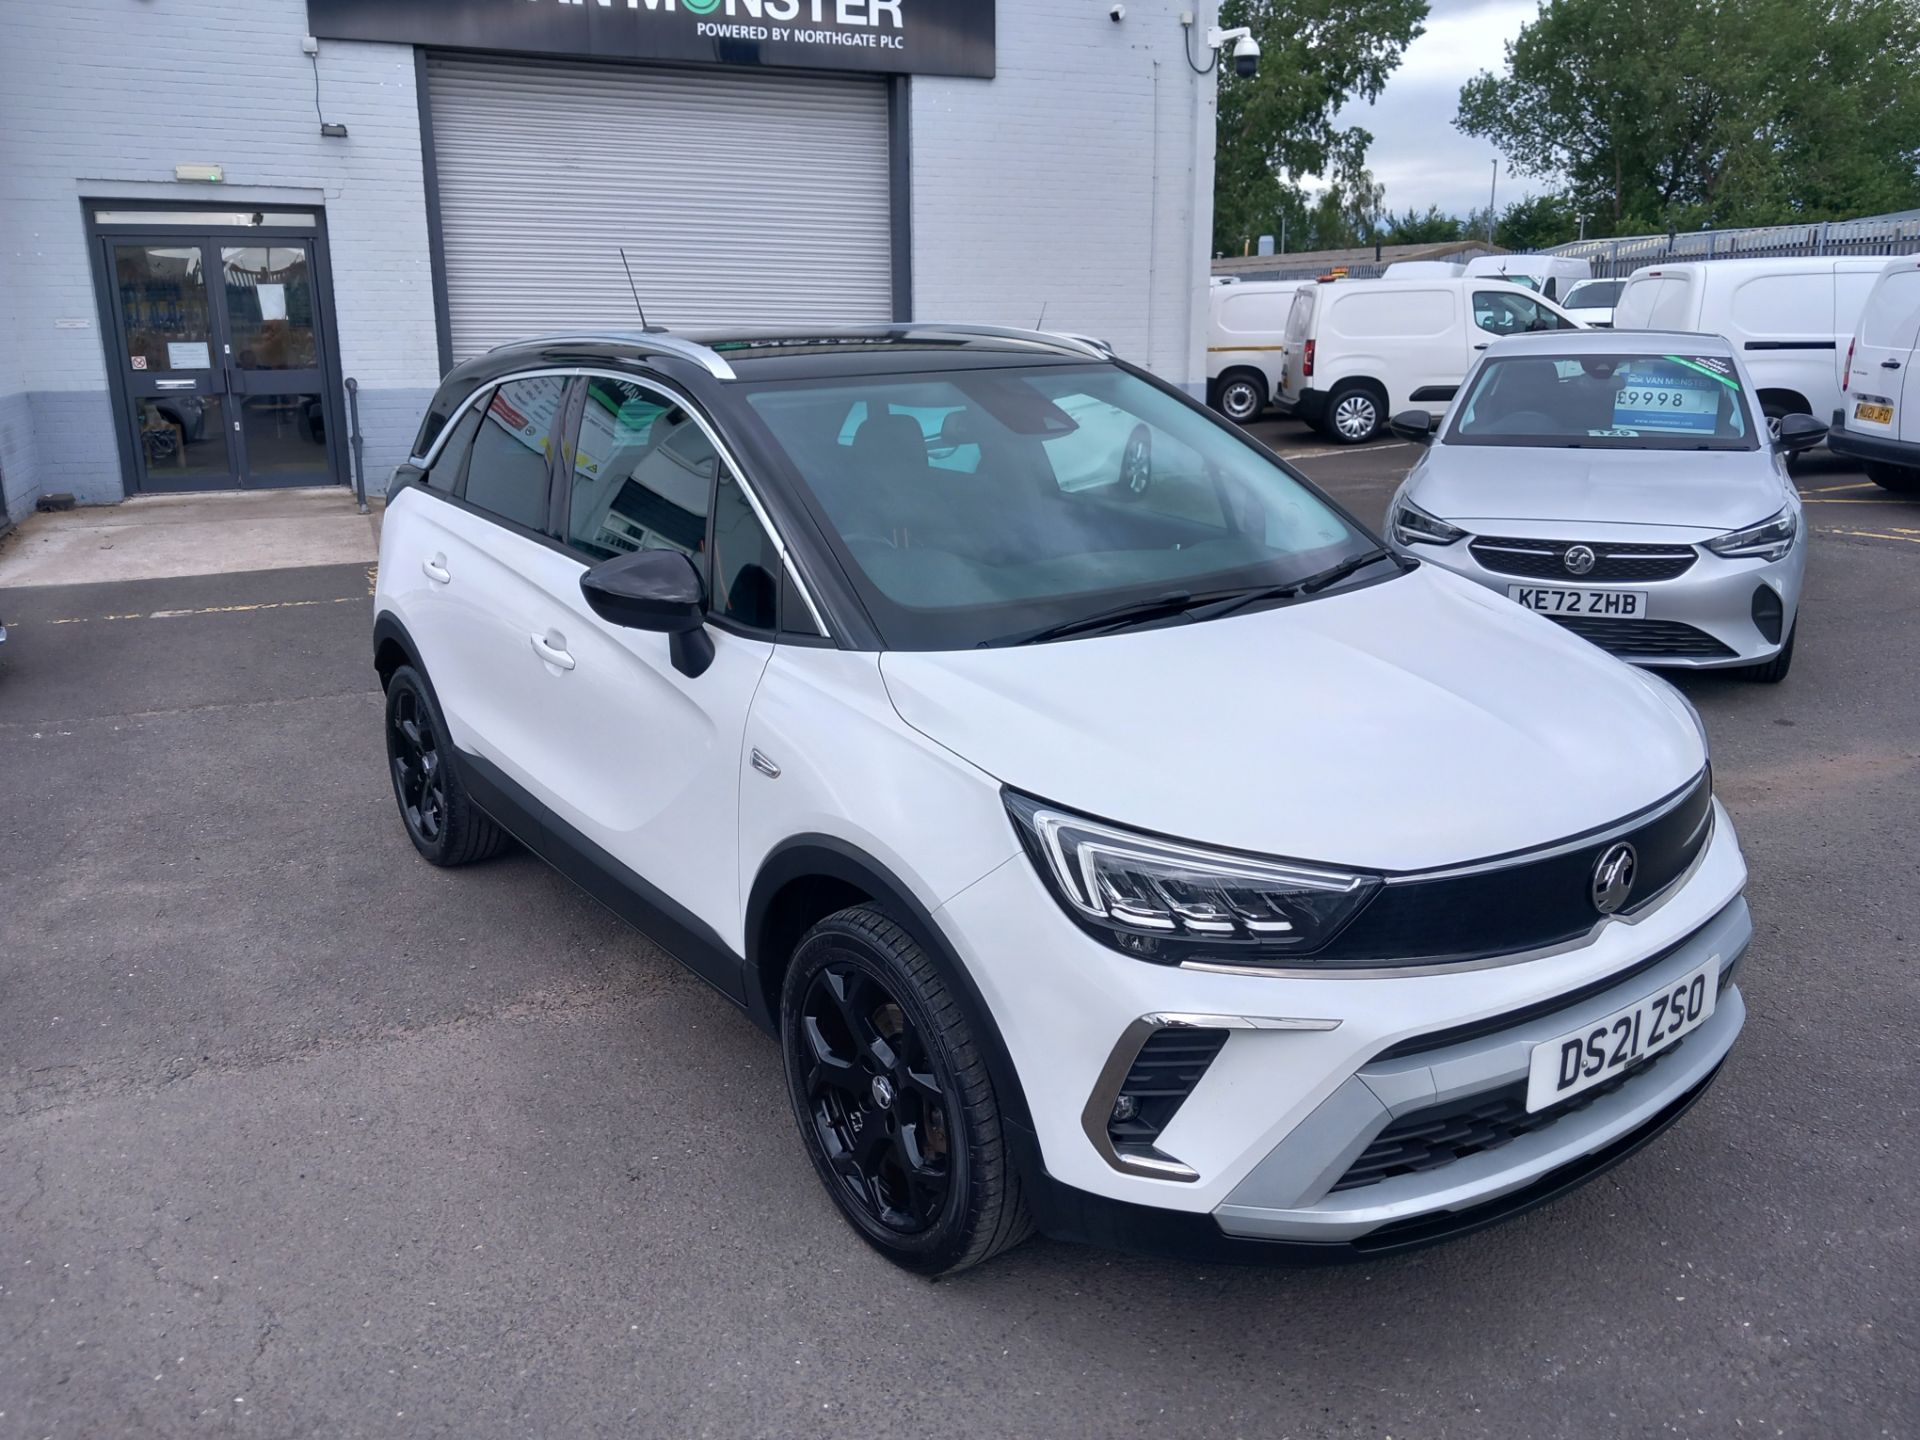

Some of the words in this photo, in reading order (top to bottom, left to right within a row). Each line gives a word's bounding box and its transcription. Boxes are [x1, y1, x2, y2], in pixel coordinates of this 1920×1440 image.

[697, 22, 768, 40] POWERED
[772, 28, 790, 42] BY
[794, 29, 877, 48] NORTHGATE
[880, 35, 904, 50] PLC
[1646, 377, 1664, 385] VAN
[1665, 379, 1712, 387] MONSTER
[1616, 390, 1683, 407] £9998
[1518, 588, 1582, 612] KE72
[1588, 593, 1637, 615] ZHB
[1557, 1009, 1642, 1092] DS21
[1647, 974, 1706, 1048] ZSO
